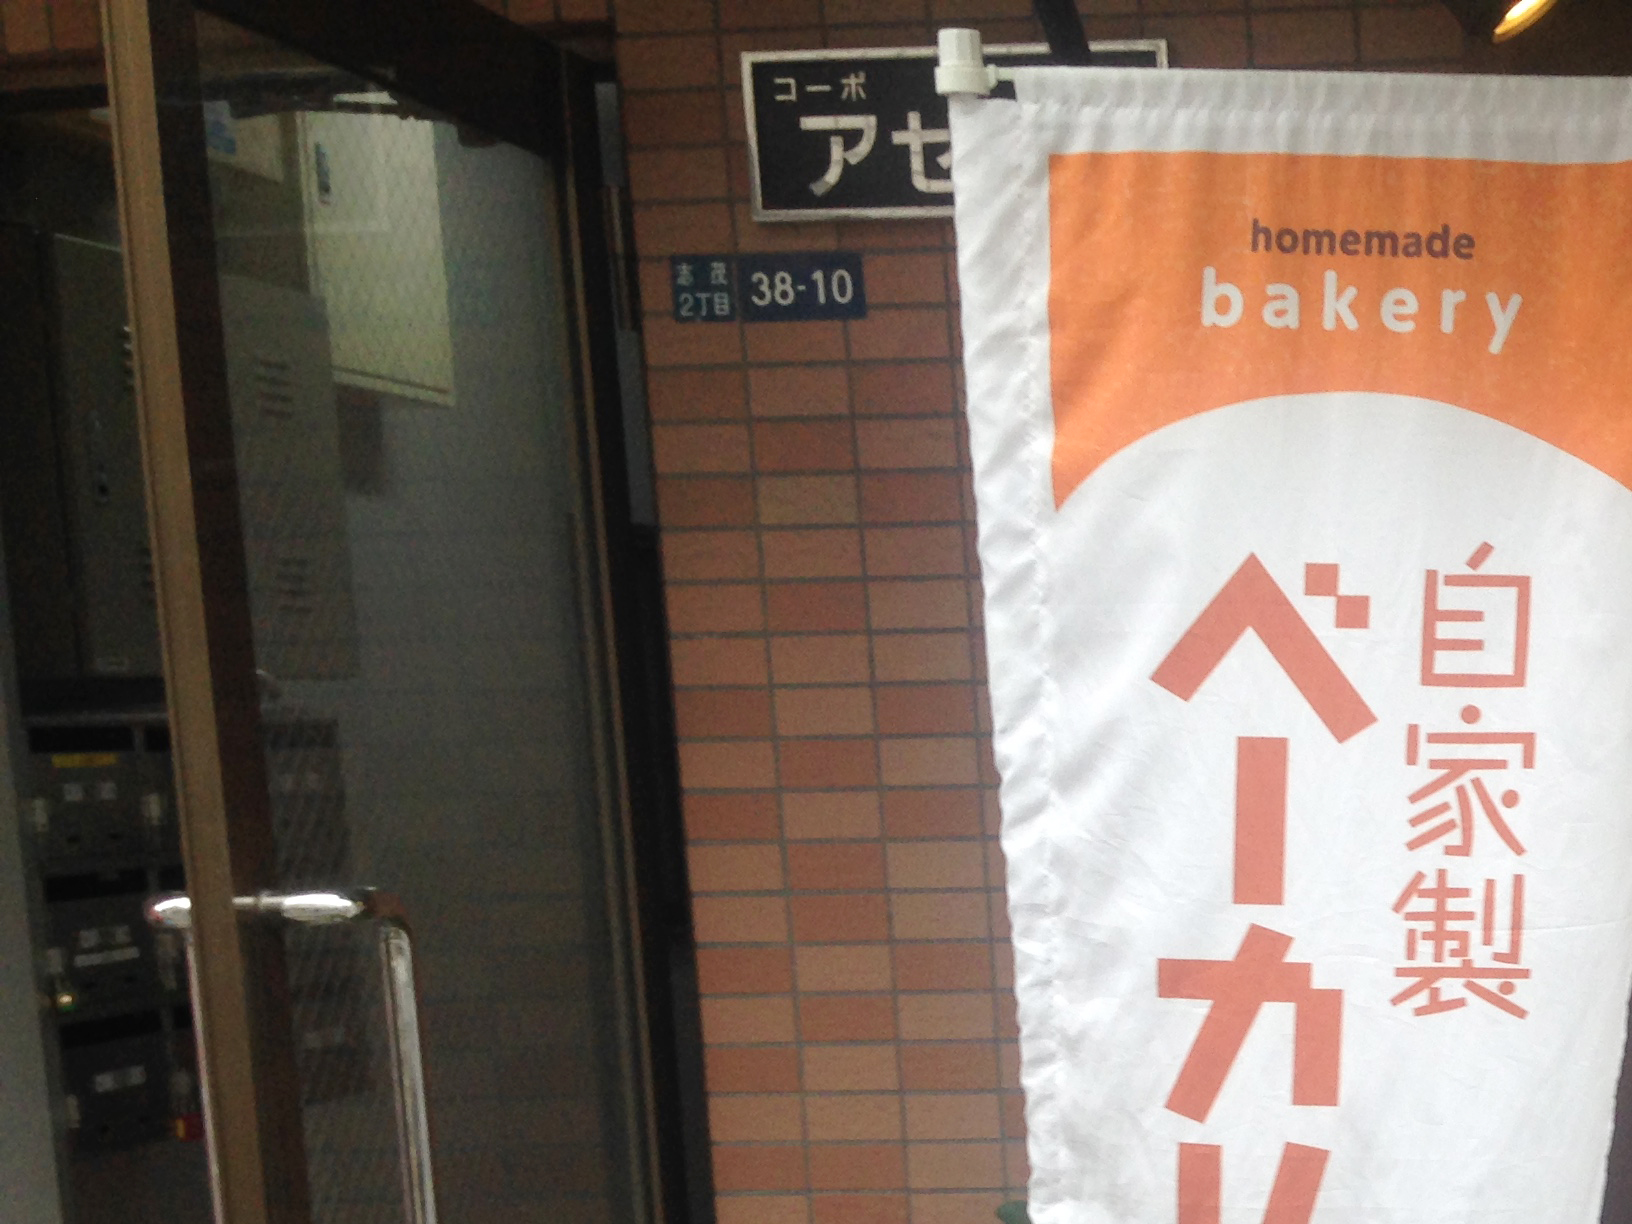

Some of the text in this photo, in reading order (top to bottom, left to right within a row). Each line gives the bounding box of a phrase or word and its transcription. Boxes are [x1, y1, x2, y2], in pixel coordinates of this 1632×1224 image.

[1250, 219, 1476, 260] homemade
[679, 291, 731, 317] 2丁目
[751, 268, 854, 307] 38-10
[1201, 266, 1523, 355] bakery
[1390, 541, 1536, 1020] 自家製
